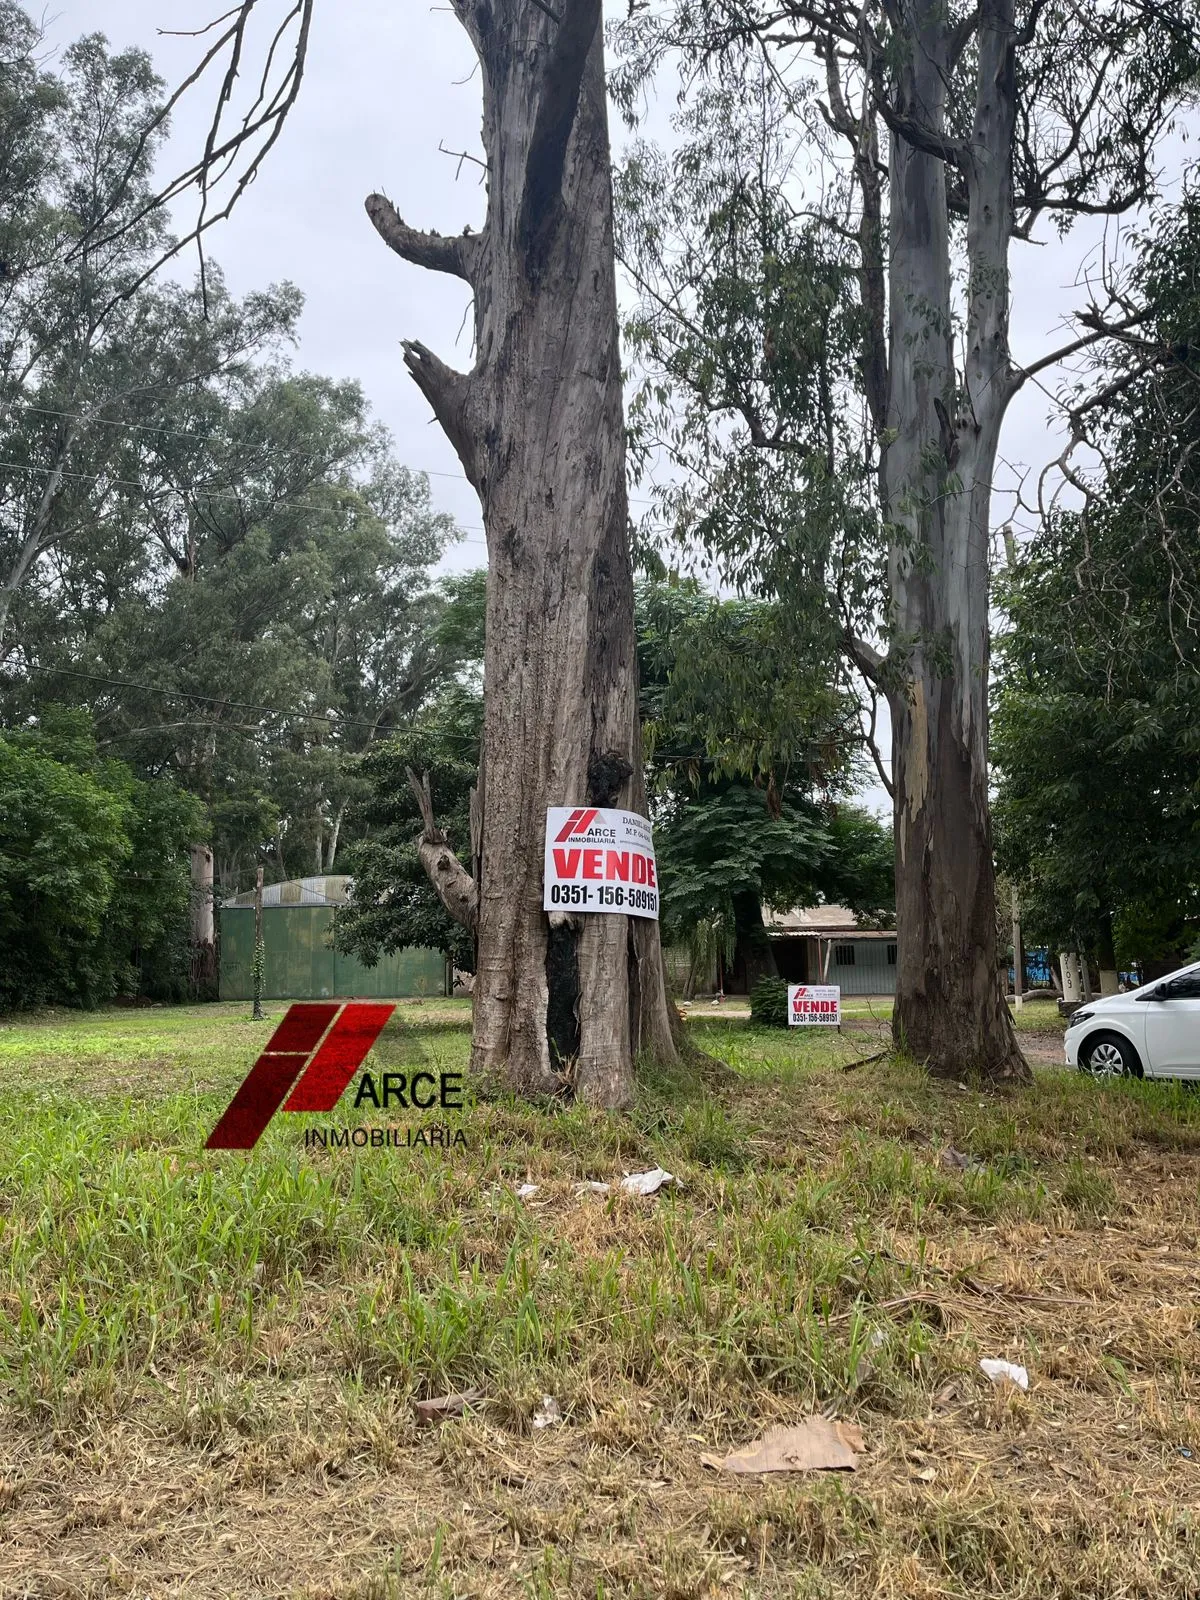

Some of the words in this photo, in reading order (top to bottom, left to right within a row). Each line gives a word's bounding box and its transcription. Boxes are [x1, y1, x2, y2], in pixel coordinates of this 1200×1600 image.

[587, 828, 616, 837] ARCE
[552, 849, 656, 888] VENDE
[551, 884, 593, 904] 0351-
[597, 886, 657, 911] 156-589151
[793, 1001, 837, 1013] VENDE
